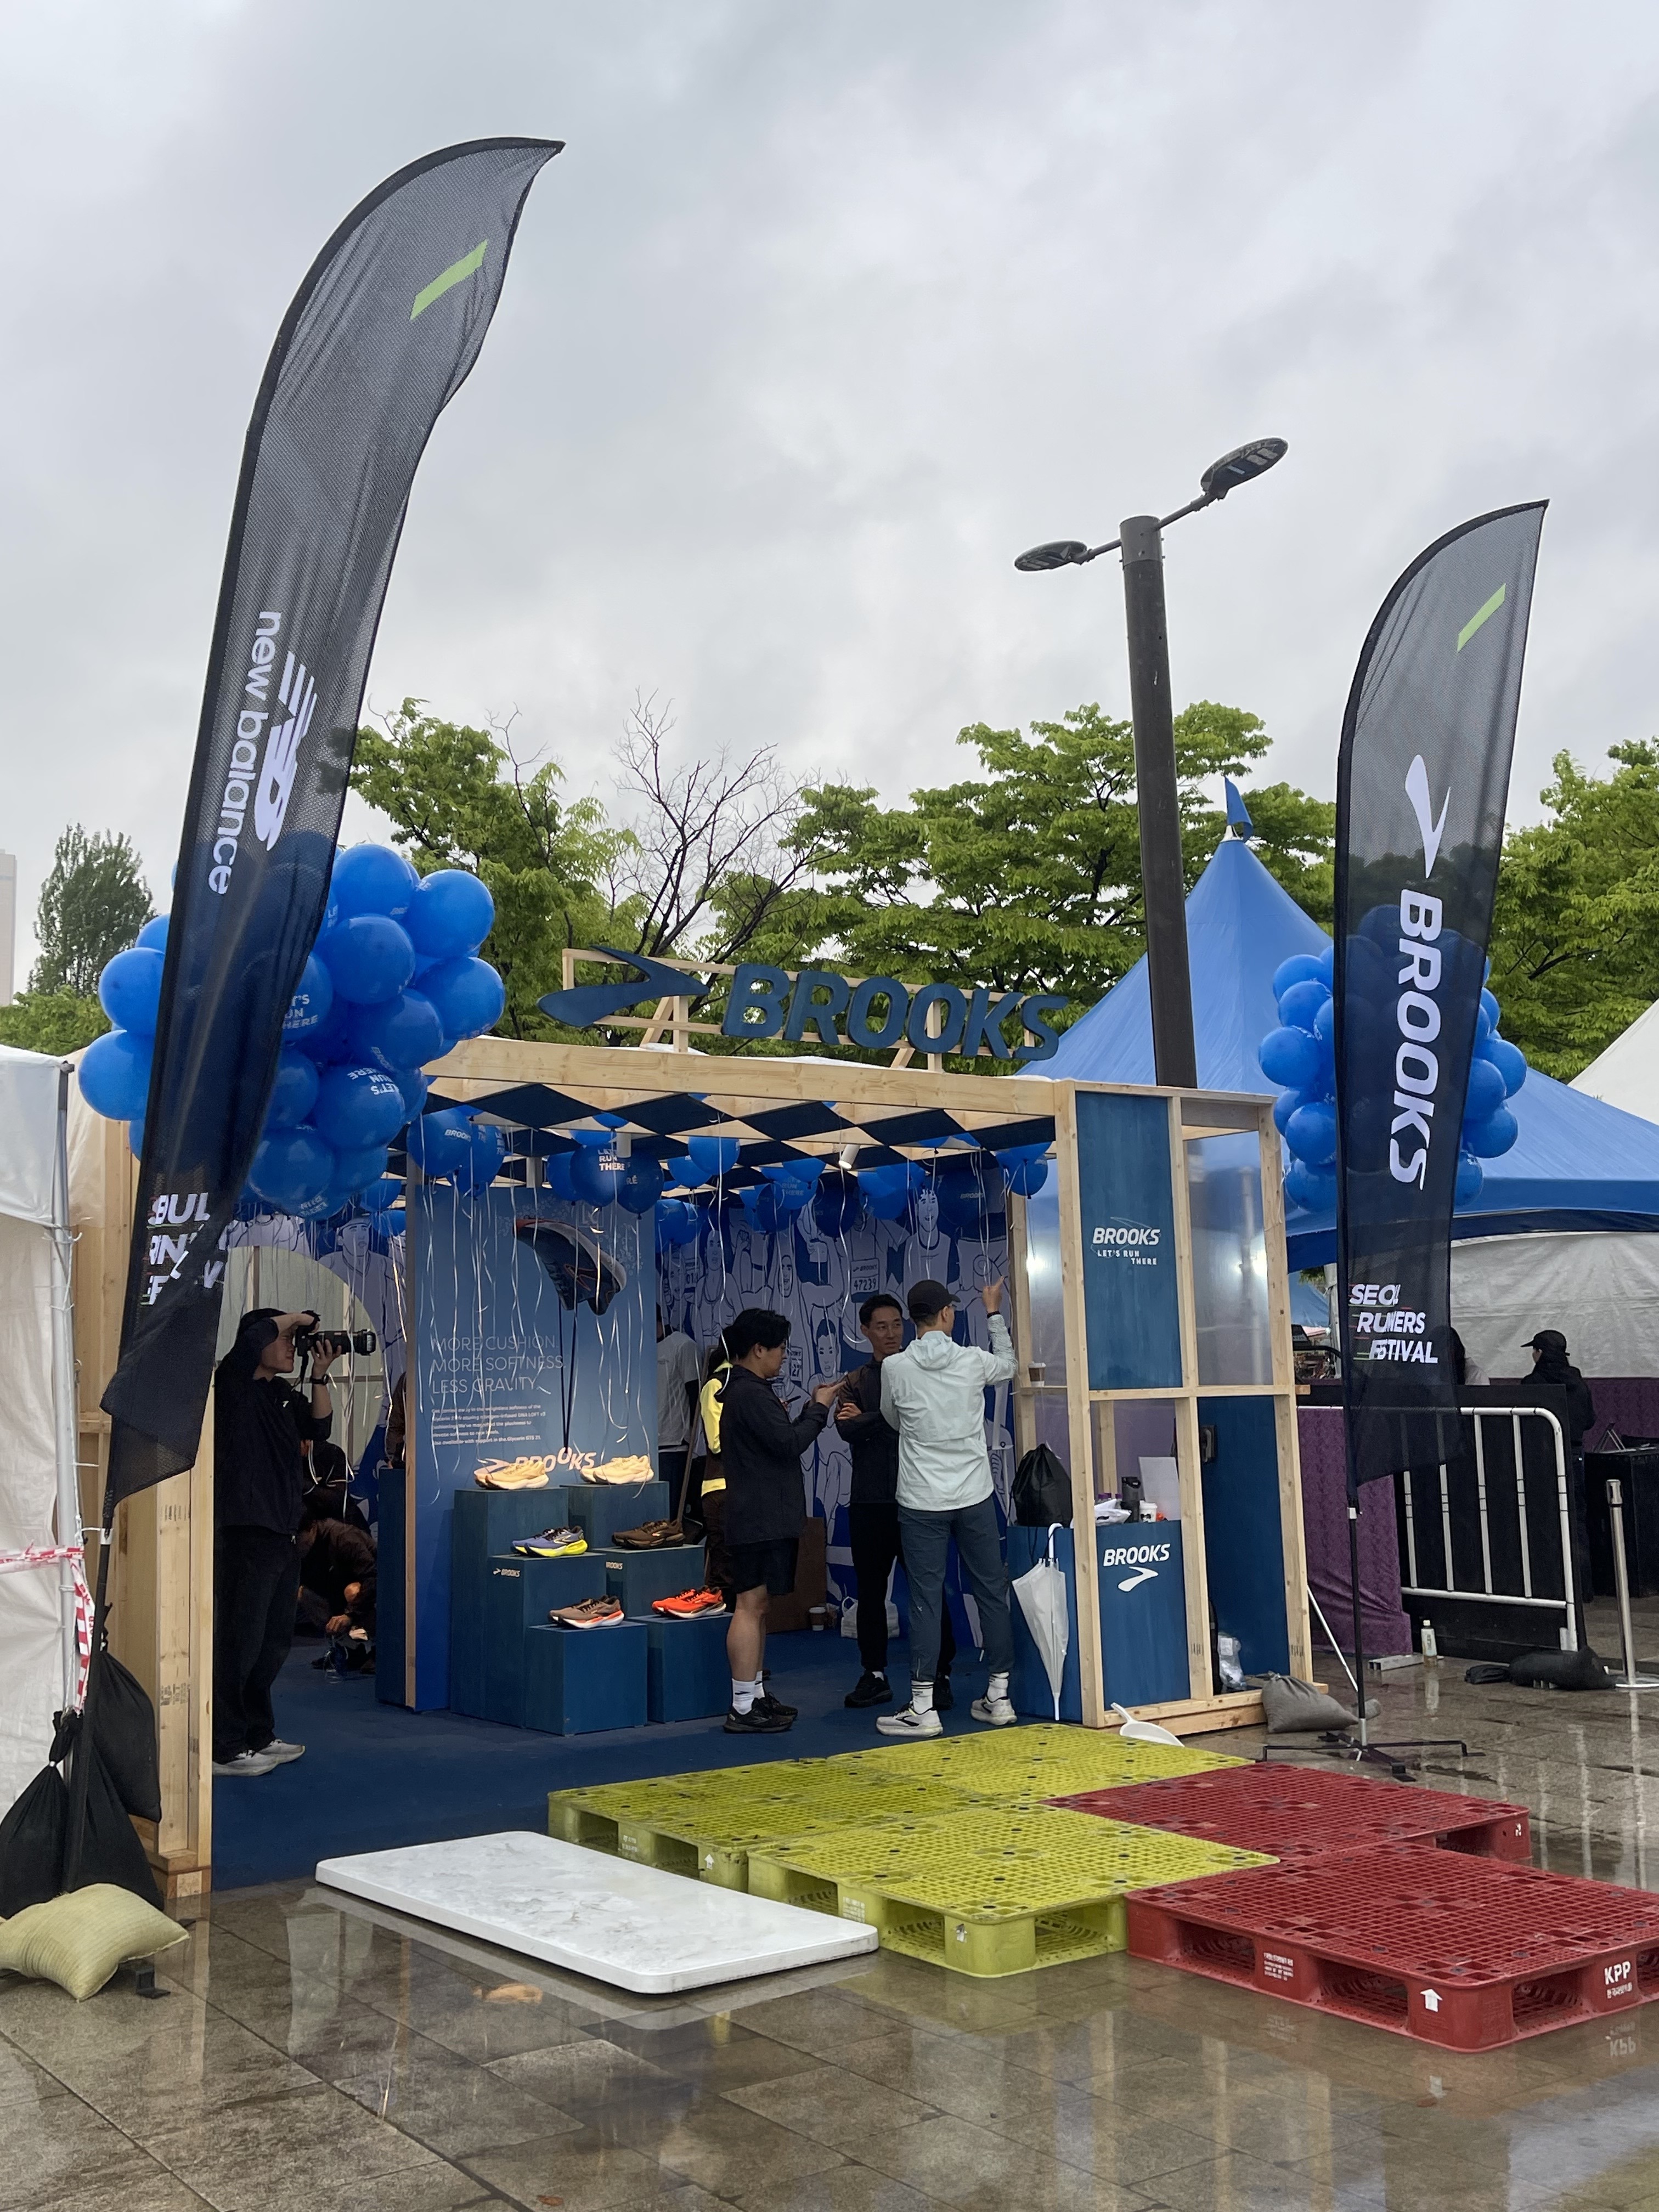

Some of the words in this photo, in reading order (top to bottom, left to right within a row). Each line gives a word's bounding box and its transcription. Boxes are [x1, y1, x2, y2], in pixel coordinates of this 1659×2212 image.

[245, 611, 281, 701] new
[208, 710, 269, 895] balance
[291, 994, 310, 1007] T'S
[284, 1008, 304, 1019] UN
[720, 962, 1069, 1061] BROOKS
[283, 1015, 318, 1030] HERE
[1390, 889, 1443, 1191] BROOKS
[444, 1129, 472, 1142] BROOKS
[599, 1163, 625, 1171] THERE
[1092, 1227, 1160, 1245] BROOKS
[1097, 1249, 1120, 1257] LET'S
[854, 1278, 877, 1290] 47239
[1357, 1311, 1426, 1334] RUERS
[432, 1337, 483, 1351] MORE
[486, 1335, 559, 1351] CUSHION.
[1368, 1339, 1438, 1363] FSTIVAL
[432, 1357, 481, 1372] MORE
[485, 1355, 566, 1371] SOFTNESS.
[432, 1379, 467, 1394] LESS
[1103, 1543, 1171, 1566] BROOKS
[501, 1568, 521, 1578] BROOKS
[1604, 1961, 1631, 1985] KPP
